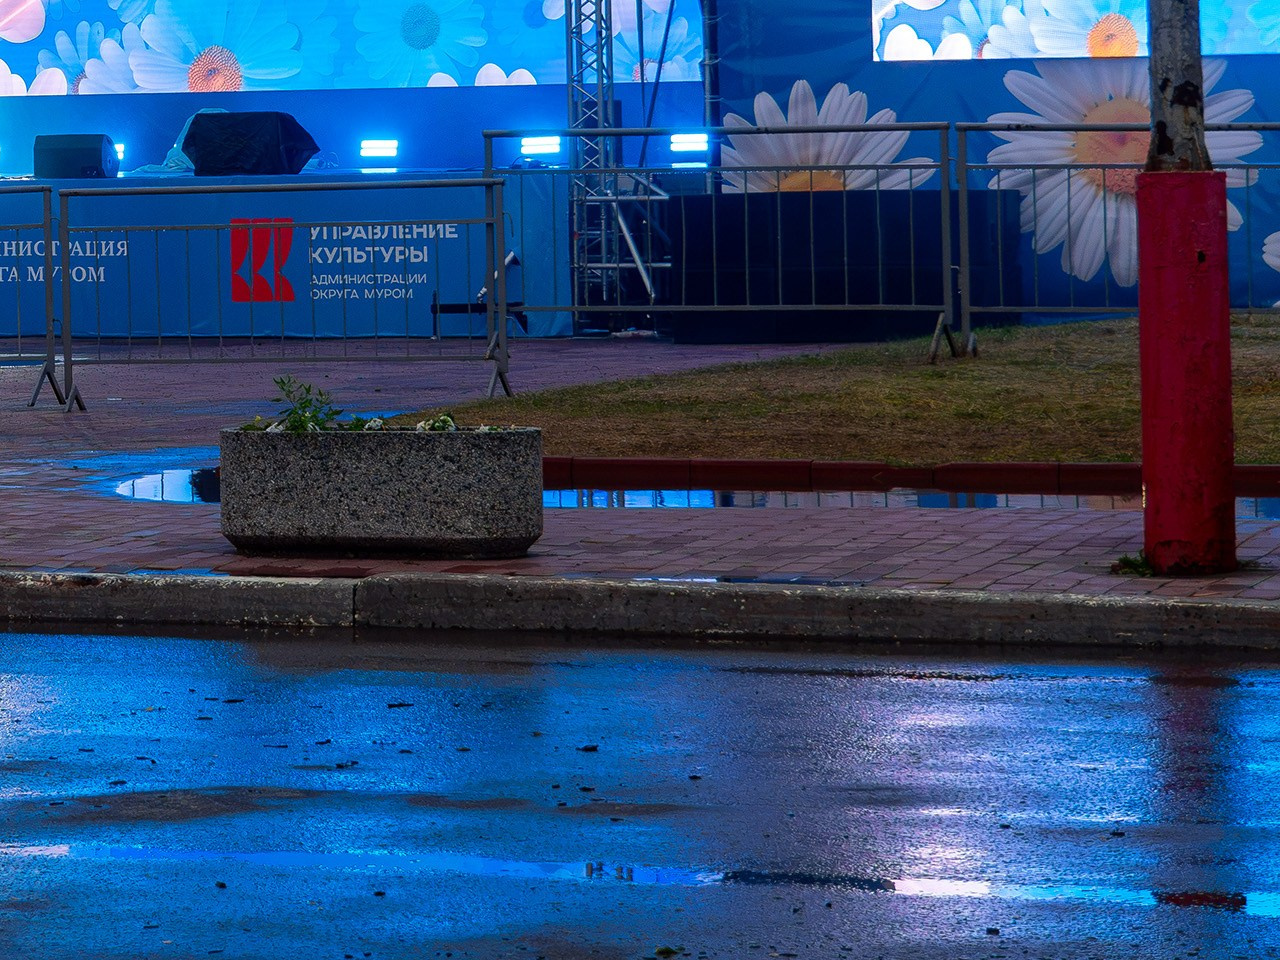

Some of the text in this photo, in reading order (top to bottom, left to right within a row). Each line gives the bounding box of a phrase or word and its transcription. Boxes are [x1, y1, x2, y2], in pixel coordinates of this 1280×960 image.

[310, 222, 459, 240] УПРАВЛЕНИЕ
[308, 245, 429, 264] КУЛЬТУРЫ
[310, 273, 428, 286] АДМИНИСТРАЦИИ
[310, 287, 414, 300] ОКРУГА МУРОМ
